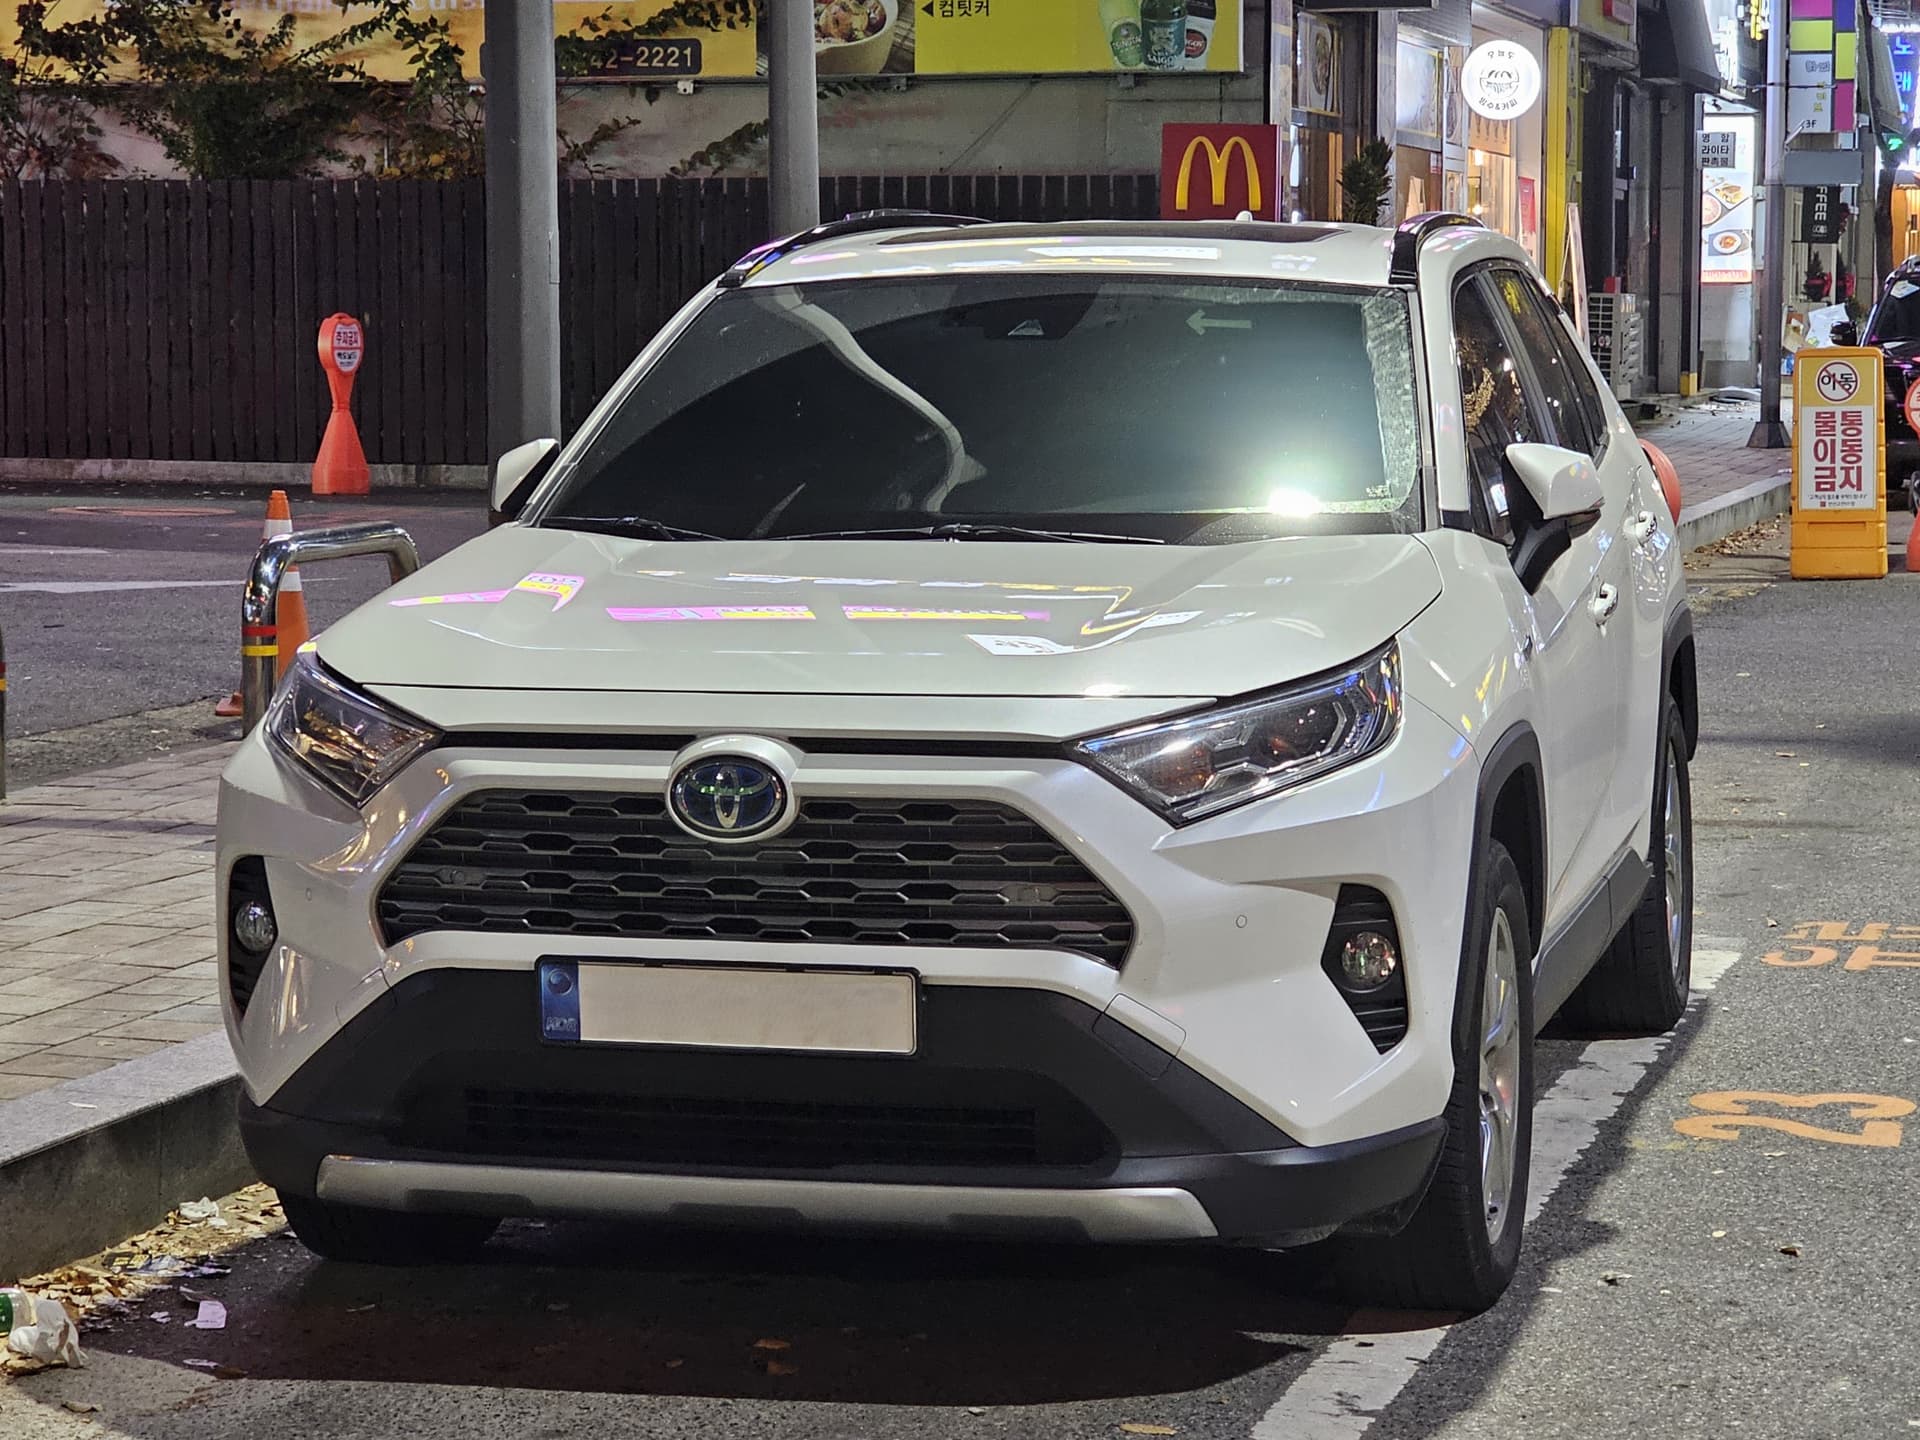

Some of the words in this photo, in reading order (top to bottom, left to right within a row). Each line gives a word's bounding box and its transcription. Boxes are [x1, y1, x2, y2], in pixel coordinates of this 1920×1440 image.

[1702, 145, 1729, 154] 라이타
[1821, 372, 1857, 391] 이동
[1814, 410, 1863, 437] 물통
[1813, 438, 1863, 465] 이동
[1814, 466, 1863, 492] 금지
